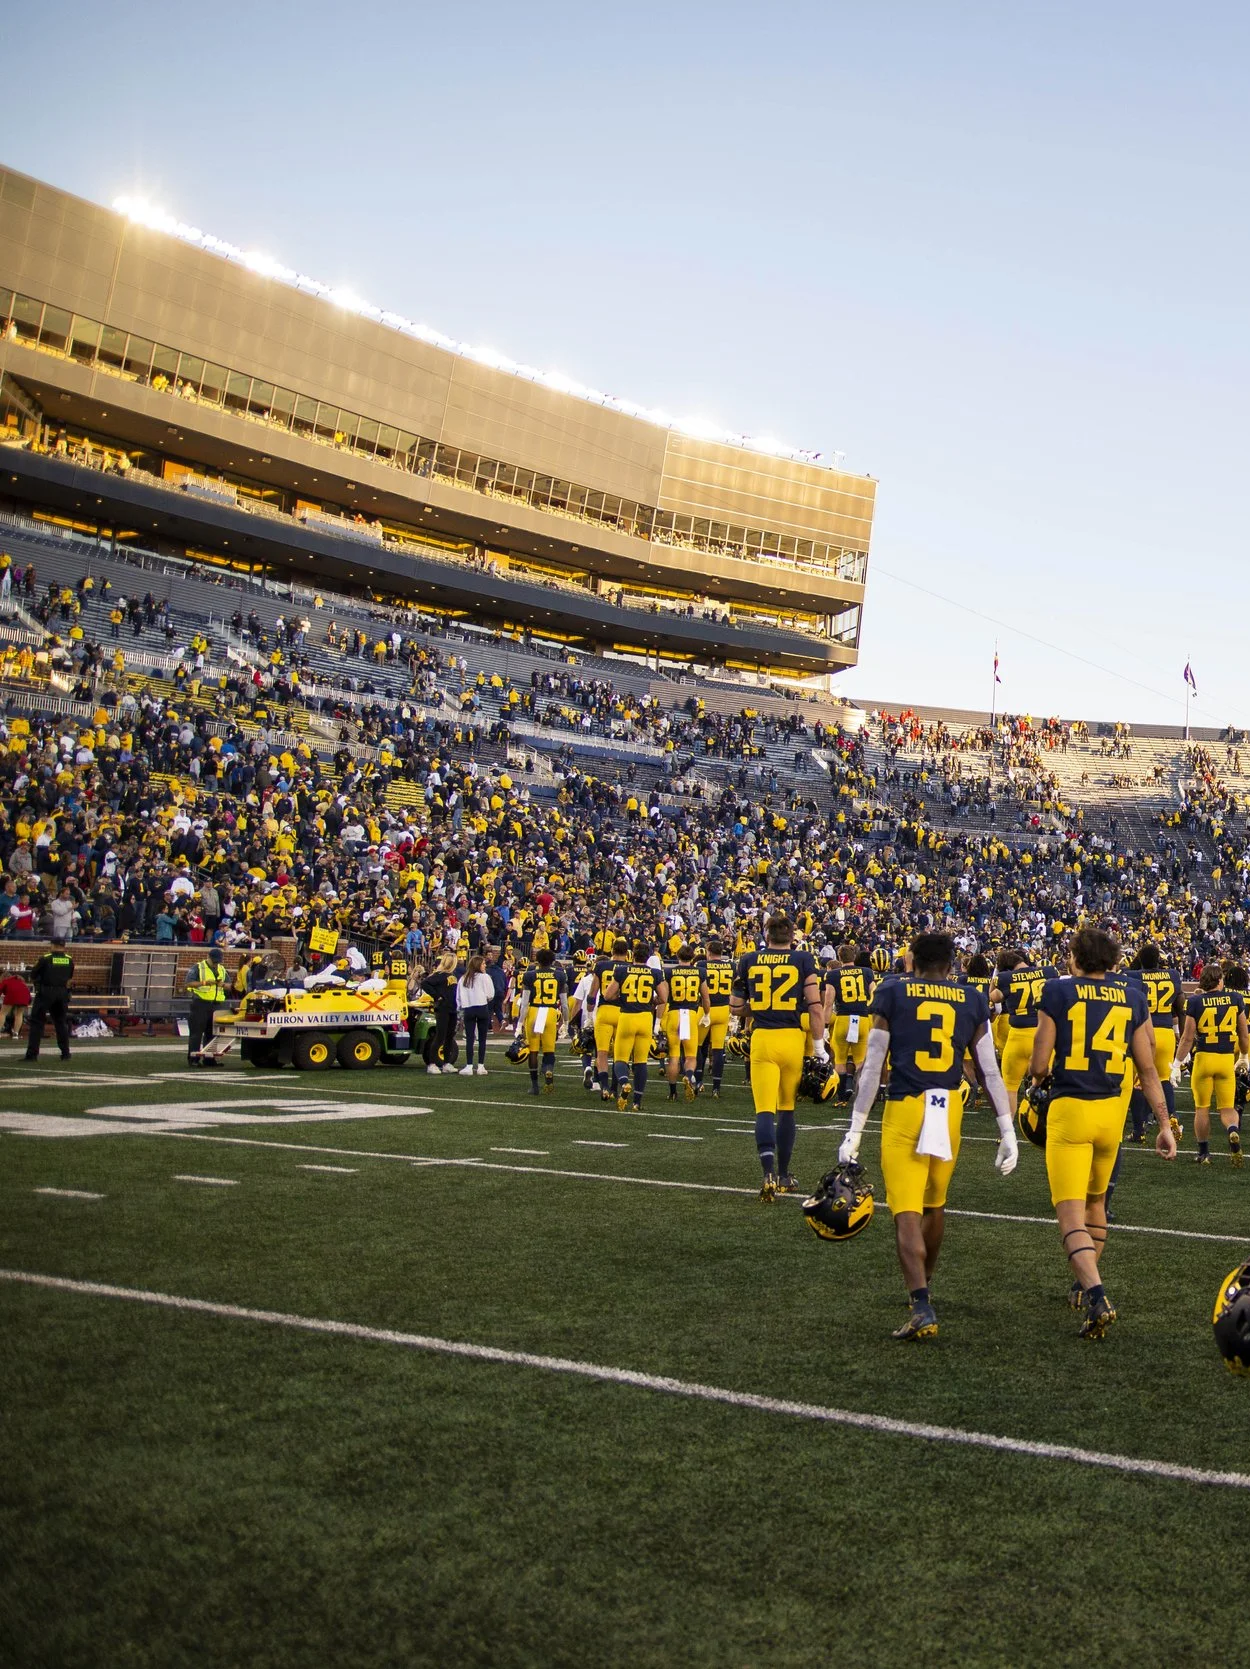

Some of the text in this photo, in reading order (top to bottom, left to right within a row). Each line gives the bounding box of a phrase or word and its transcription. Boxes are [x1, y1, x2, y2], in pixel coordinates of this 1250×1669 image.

[757, 954, 791, 964] KNIGHT
[840, 968, 863, 976] HANSEN
[621, 974, 655, 1004] 46
[670, 975, 700, 1002] 88
[706, 969, 733, 995] 35
[748, 965, 799, 1011] 32
[840, 974, 867, 1003] 81
[1012, 970, 1044, 982] STEWART
[533, 979, 558, 1005] 19
[906, 983, 966, 1003] HENNING
[1075, 984, 1127, 1003] WILSON
[1202, 995, 1232, 1007] LUTHER
[269, 1013, 400, 1024] HURON VALLEY AMBULANCE
[1198, 1005, 1239, 1044] 44
[915, 1000, 956, 1073] 3
[1064, 1001, 1133, 1075] 14
[931, 1094, 946, 1108] M
